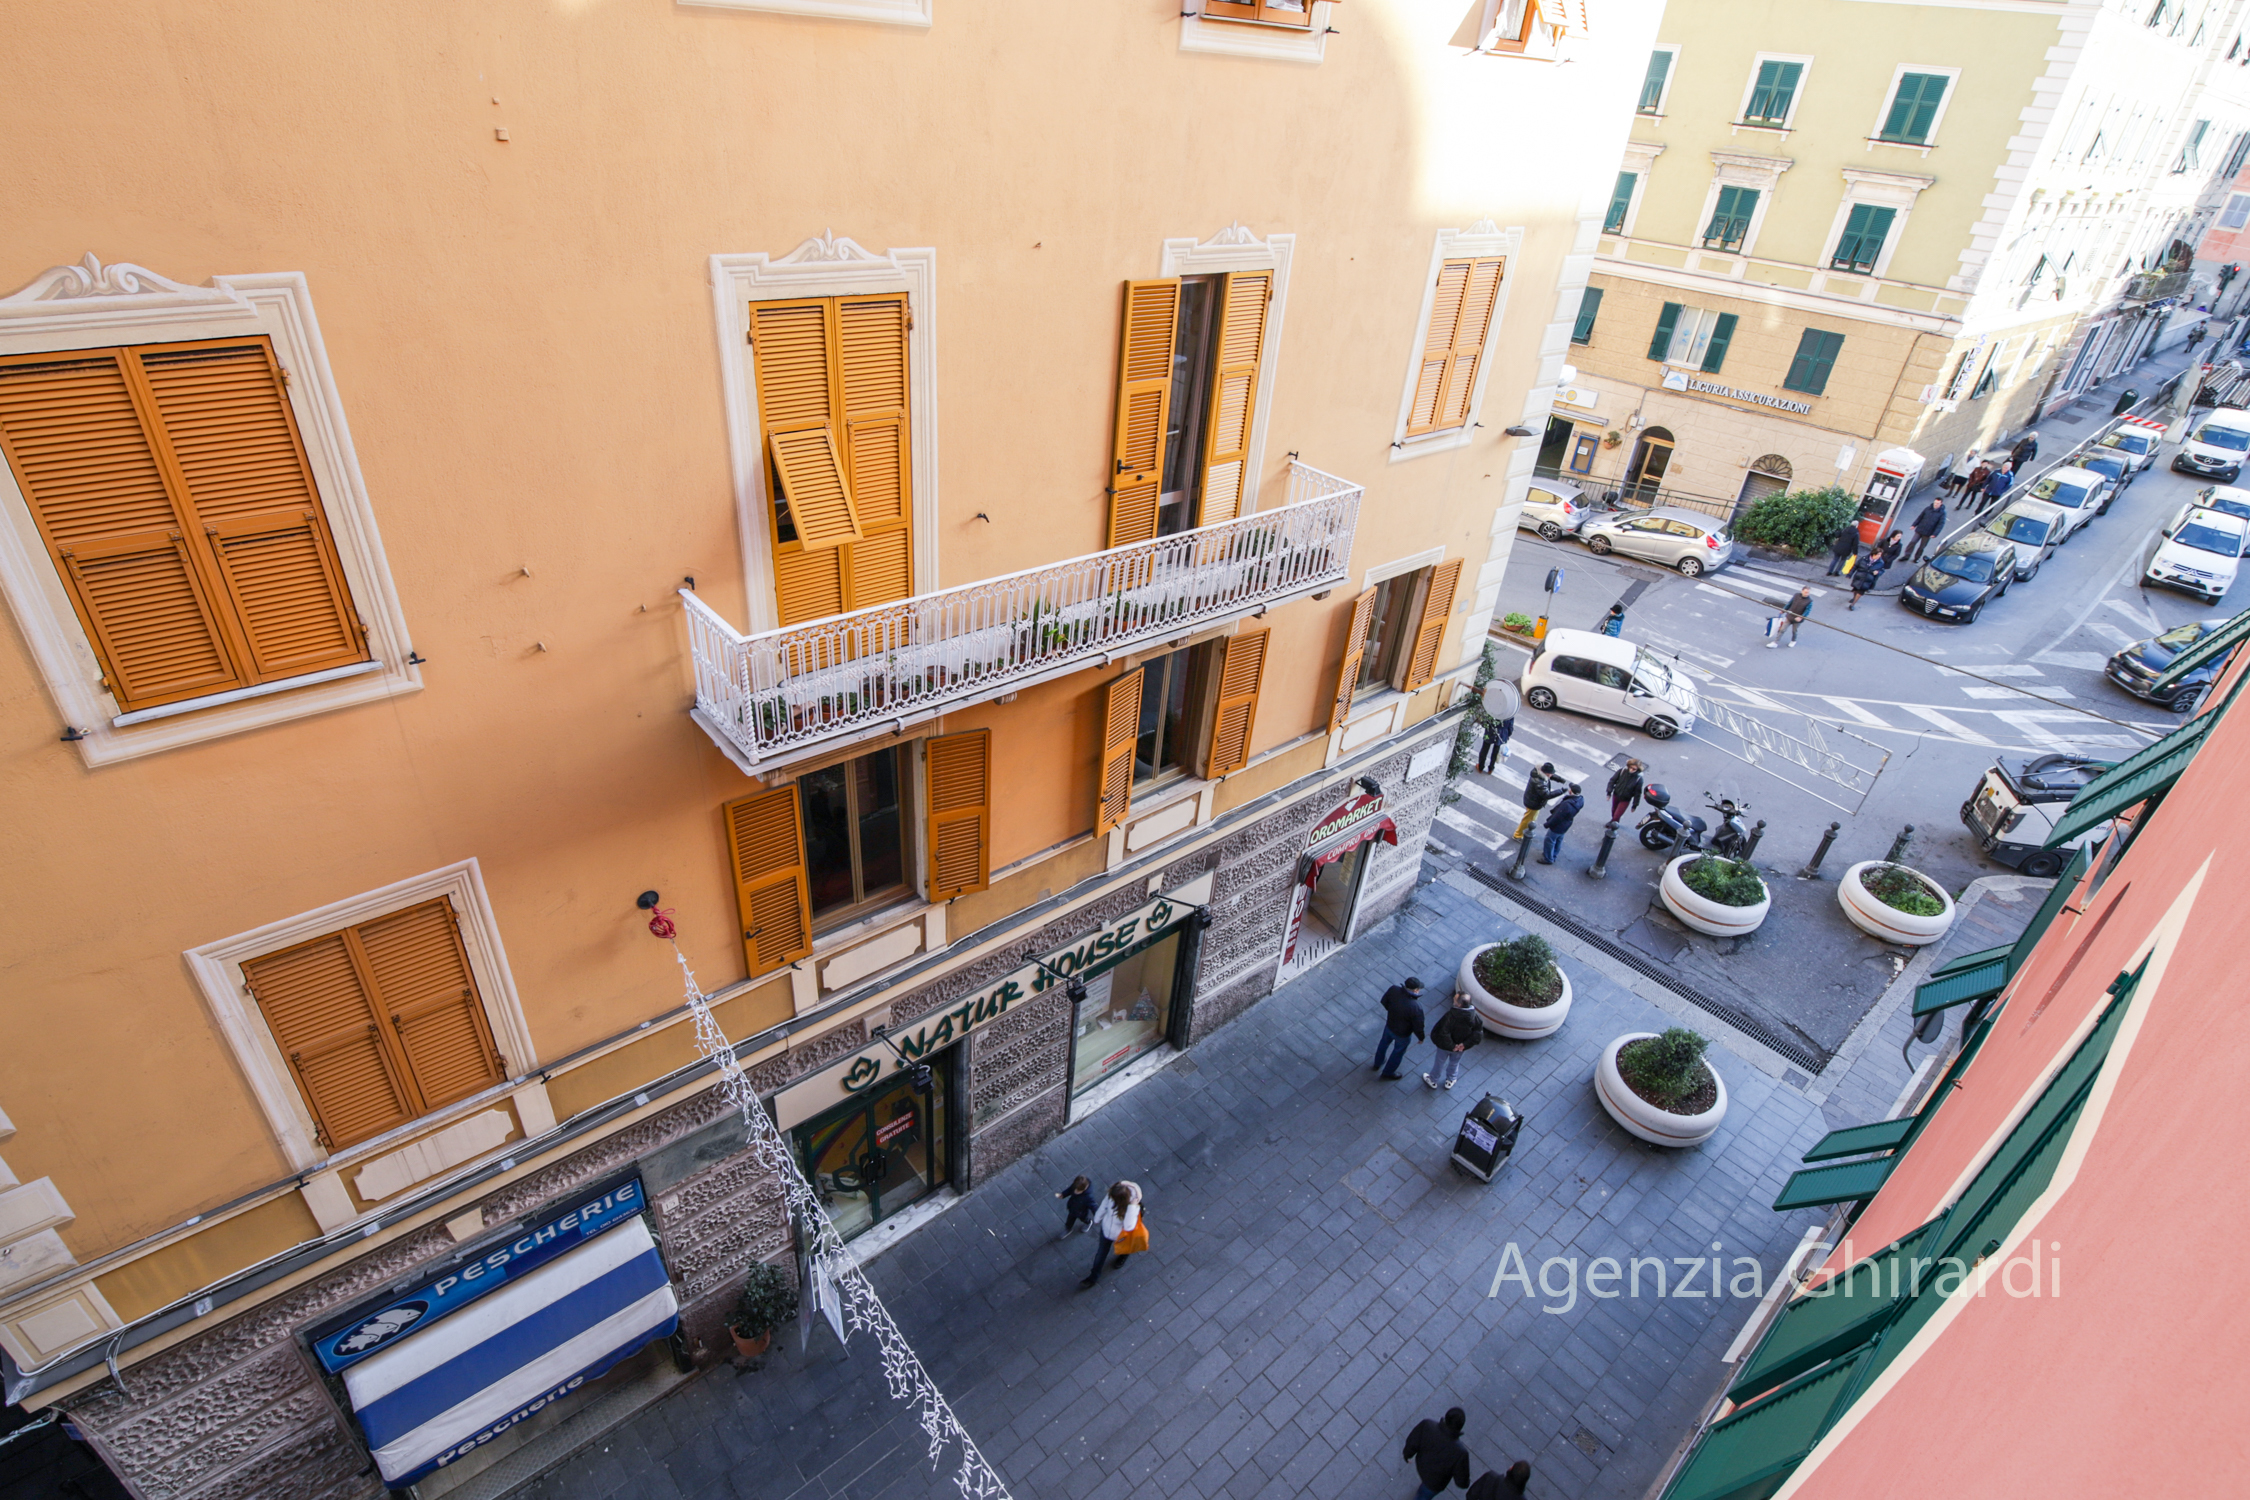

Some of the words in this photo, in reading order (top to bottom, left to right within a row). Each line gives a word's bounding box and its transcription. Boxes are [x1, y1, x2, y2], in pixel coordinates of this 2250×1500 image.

[1688, 379, 1730, 397] LIGURIA
[1730, 389, 1812, 415] ASSICURAZIONI
[1310, 796, 1383, 845] OROMARKET
[1327, 834, 1361, 860] COMPRO
[1363, 822, 1381, 838] ORO
[876, 1111, 913, 1136] CONSULENZE
[879, 1122, 910, 1143] GRATUITE
[435, 1184, 635, 1297] PESCHERIE
